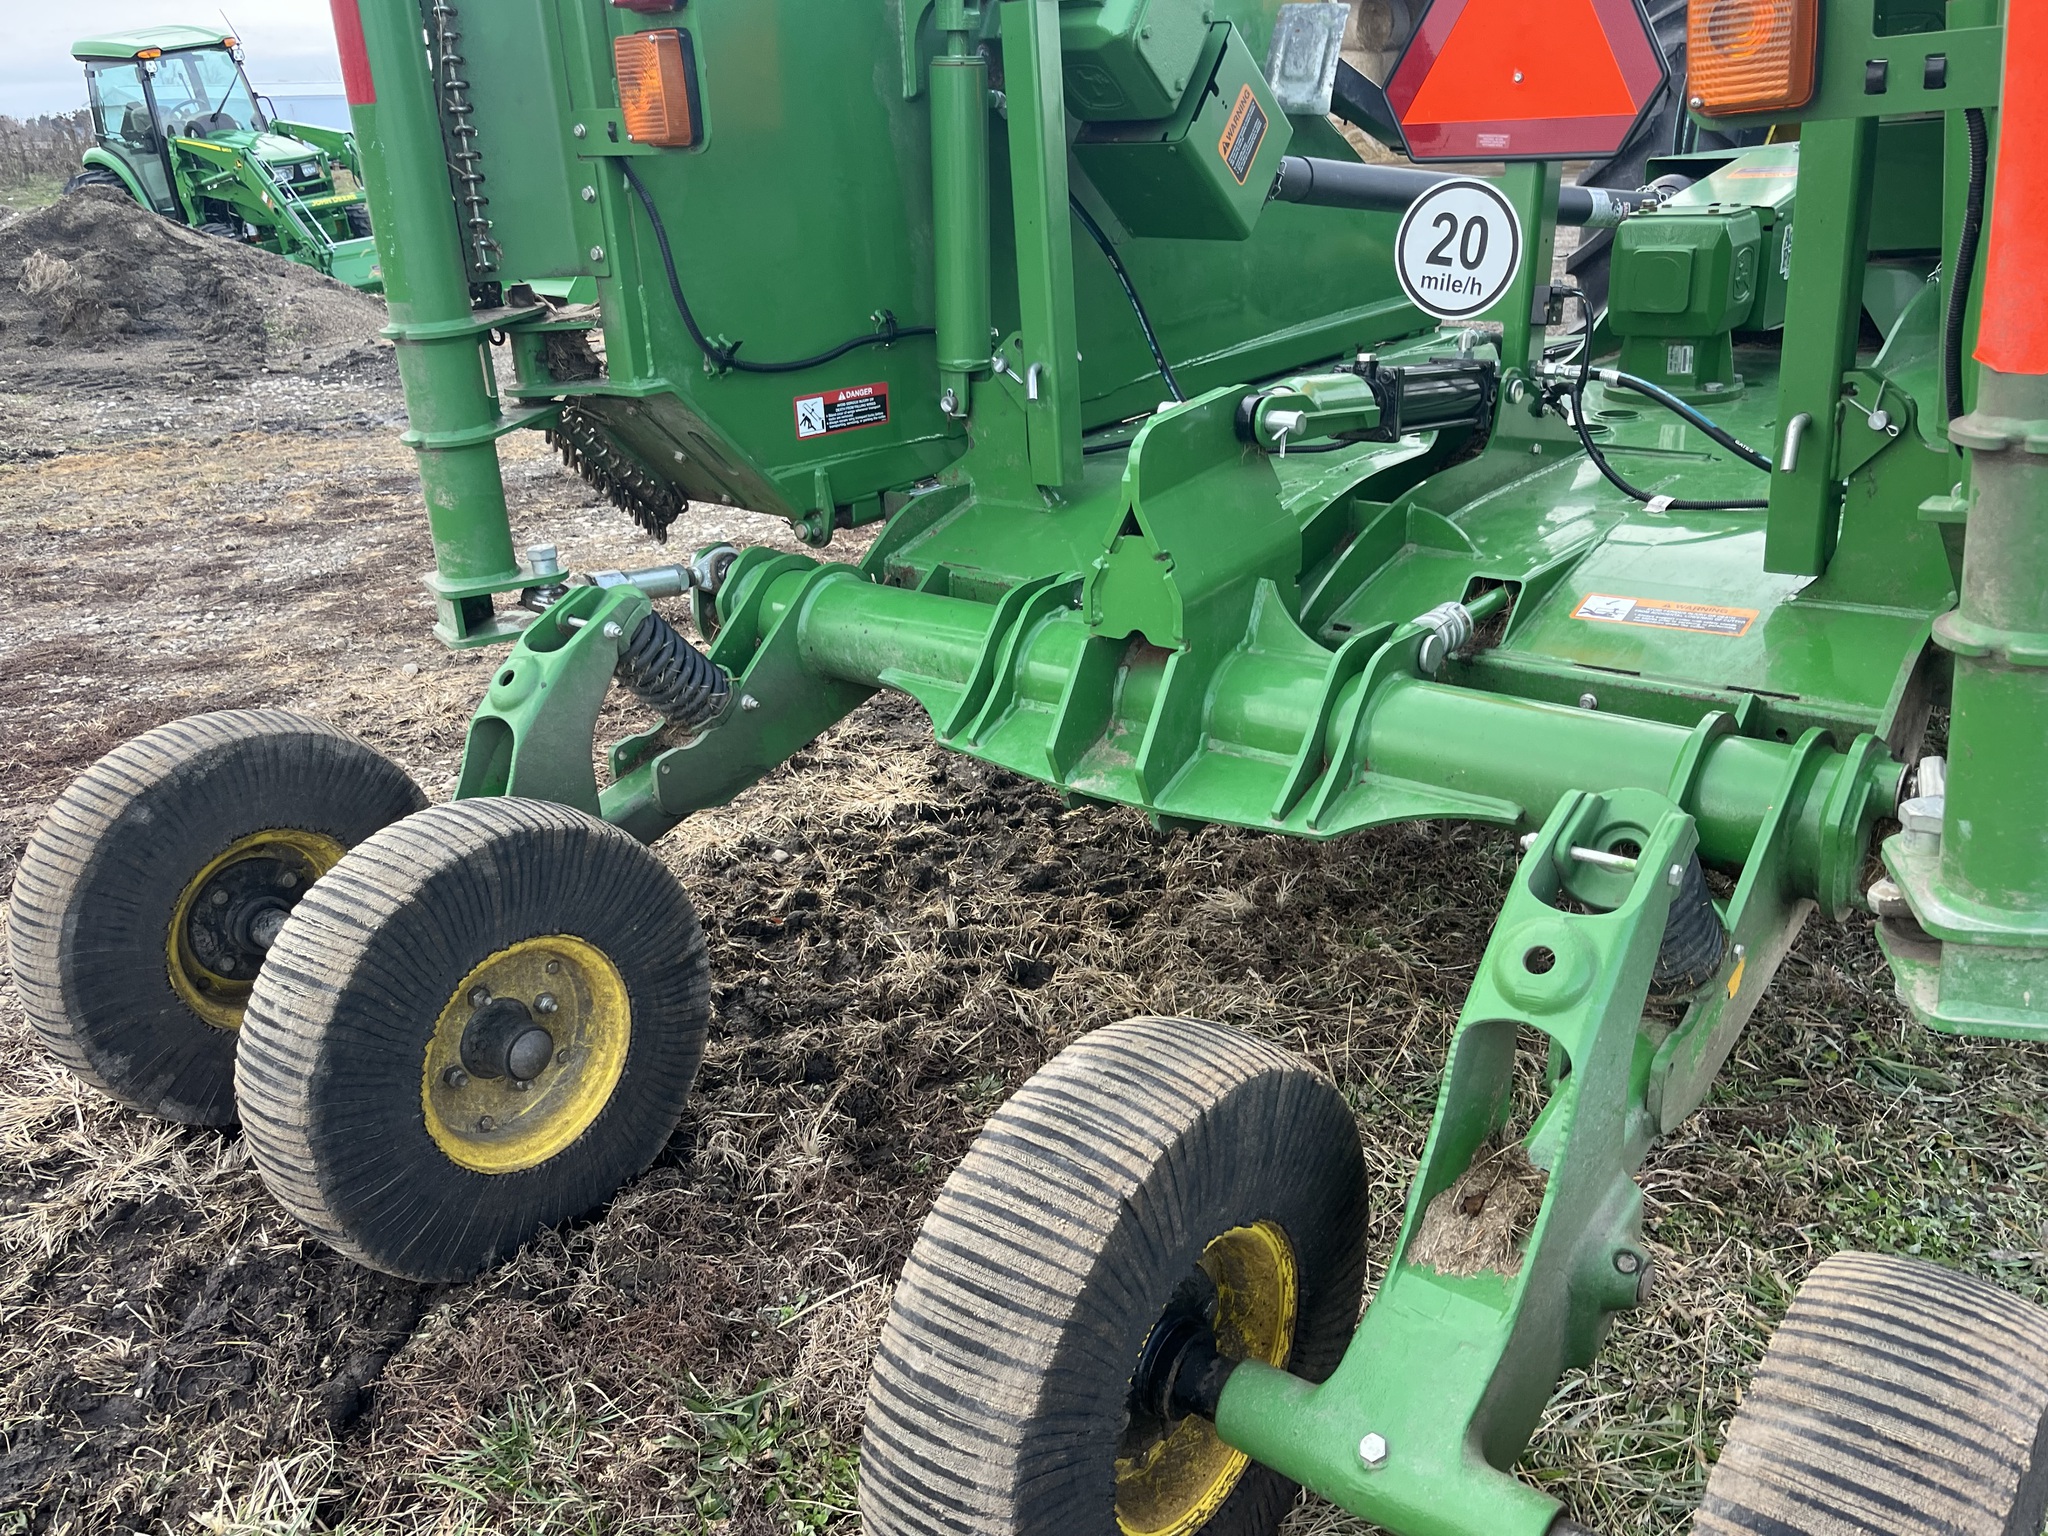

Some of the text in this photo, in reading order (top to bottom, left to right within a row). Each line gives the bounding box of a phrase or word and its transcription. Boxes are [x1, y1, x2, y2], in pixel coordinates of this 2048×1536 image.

[1226, 89, 1250, 142] WARNING
[1425, 212, 1489, 271] 20
[1420, 273, 1483, 296] mile/h
[846, 387, 873, 399] DANGER
[1676, 604, 1729, 614] WARNING
